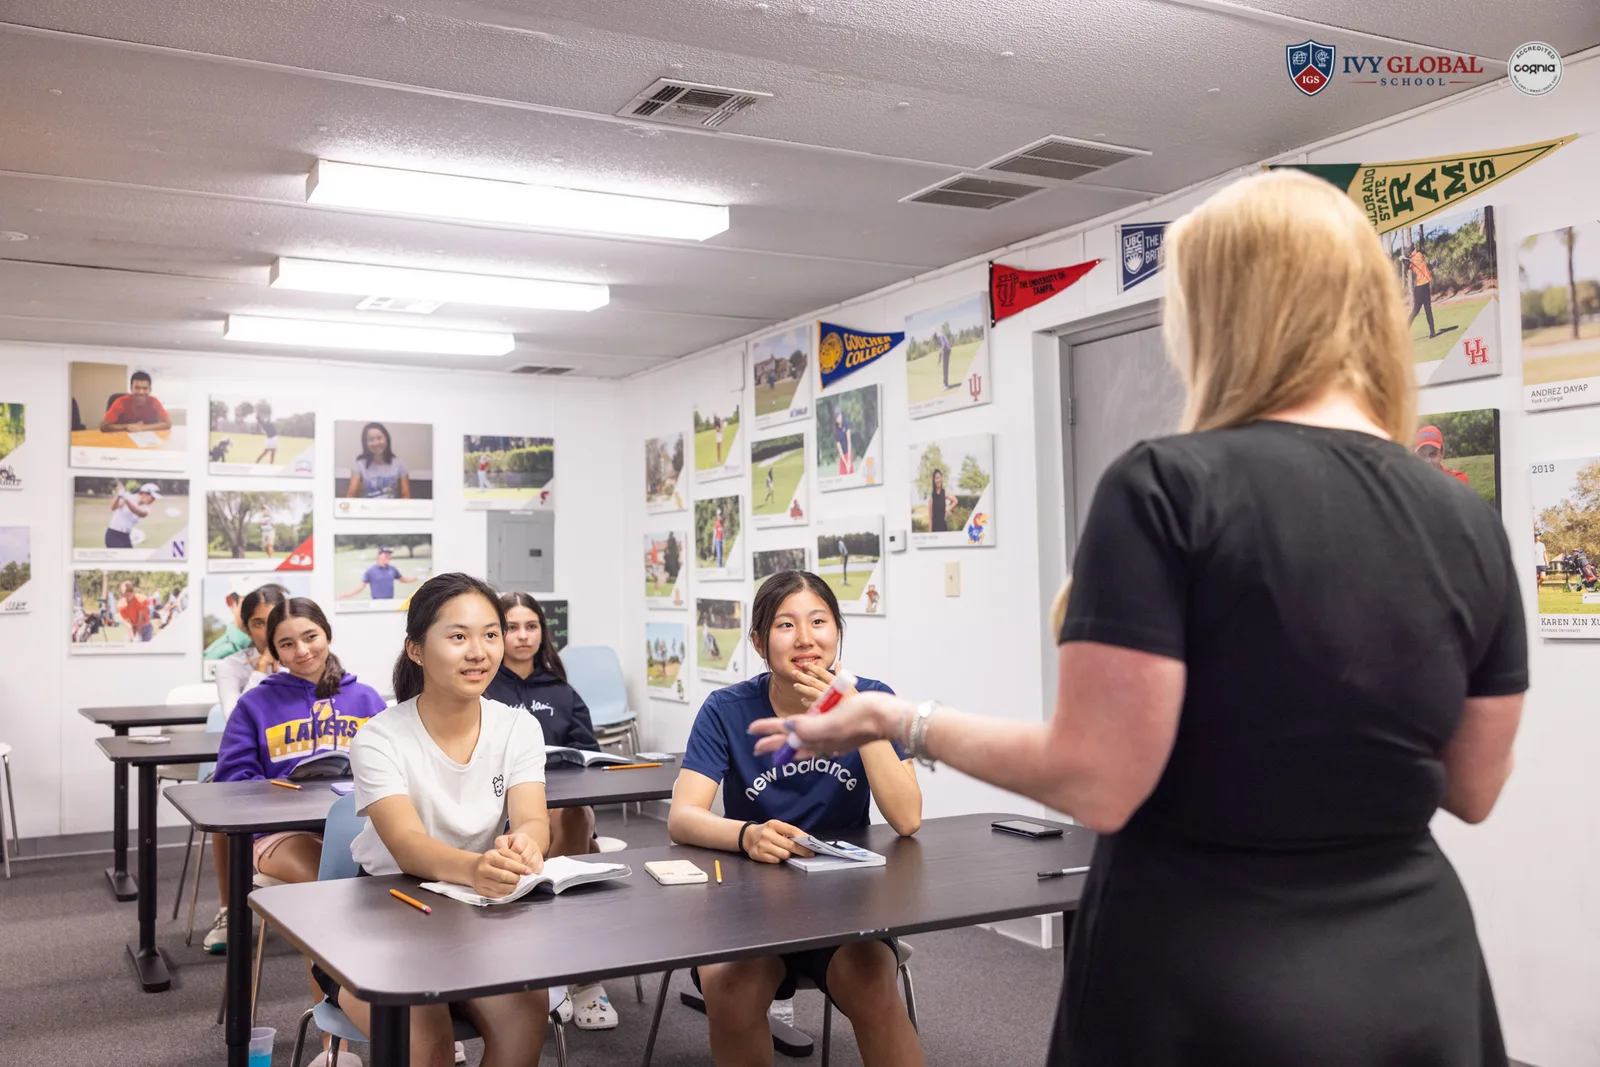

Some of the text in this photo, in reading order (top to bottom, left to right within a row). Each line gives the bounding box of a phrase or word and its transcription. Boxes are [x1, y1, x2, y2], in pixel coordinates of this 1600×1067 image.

[1389, 159, 1496, 217] RAMS
[1362, 168, 1378, 232] OLORADO
[1375, 180, 1391, 221] STATE
[1125, 234, 1142, 247] UBC
[1144, 234, 1159, 248] THE
[1019, 280, 1029, 289] THE
[843, 333, 892, 351] GOUCHER
[845, 343, 891, 368] COLLEGE
[1531, 383, 1588, 398] ANDREZ DAYAP
[1532, 463, 1555, 474] 2019
[1541, 617, 1569, 626] KAREN
[1572, 617, 1588, 626] XIN
[284, 719, 359, 745] LAKERS
[744, 755, 858, 801] new balance
